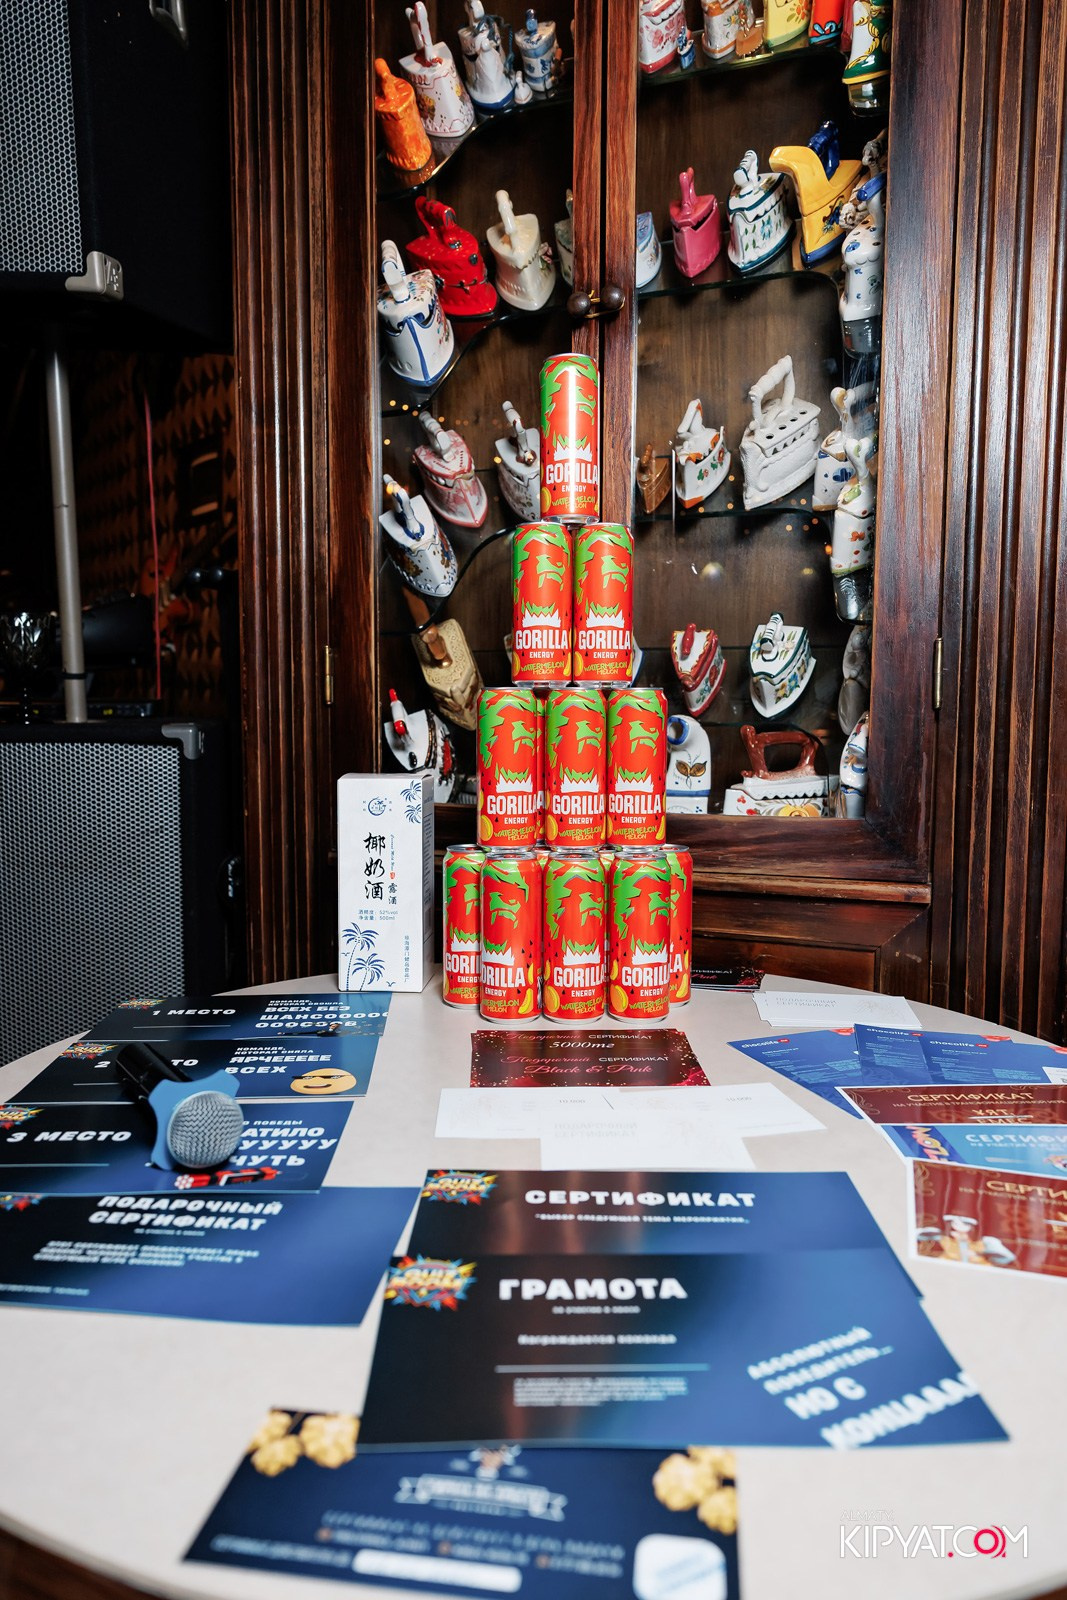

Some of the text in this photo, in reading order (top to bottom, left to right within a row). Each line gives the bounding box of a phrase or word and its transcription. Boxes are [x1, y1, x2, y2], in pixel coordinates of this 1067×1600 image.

[561, 484, 587, 493] ENRGY
[515, 629, 568, 650] GORILLA
[578, 629, 631, 650] GORILLA
[529, 651, 555, 659] ENERGY
[593, 651, 618, 659] ENERGY
[521, 661, 565, 672] WATERMELON
[584, 661, 628, 672] WATERMELON
[552, 793, 605, 815] GORILLA
[608, 793, 662, 814] GORILLA
[504, 816, 529, 825] ENERGY
[568, 816, 594, 825] ENERGY
[621, 815, 647, 824] ENERGY
[614, 825, 657, 837] WATERMELON
[363, 831, 386, 900] 椰奶酒
[445, 952, 481, 974] GORI
[457, 975, 481, 983] ENERG
[622, 963, 670, 988] GORILL
[485, 987, 507, 997] ENERGY
[571, 989, 596, 998] ENERGY
[640, 988, 664, 997] ENERGY
[167, 1008, 237, 1016] МЕСТО
[866, 1027, 909, 1037] chocolife
[929, 1040, 975, 1048] chocolife
[94, 1060, 111, 1069] 2
[224, 1065, 288, 1074] ВСЕХ
[523, 1064, 653, 1075] Black & Pink
[907, 1092, 1034, 1102] СЕРТИФИКАТ
[7, 1130, 132, 1142] 3 МЕСТО
[241, 1127, 326, 1138] АТИЛО
[229, 1154, 306, 1167] ЧУТЬ
[525, 1190, 756, 1207] СЕРТИФИКАТ
[97, 1195, 284, 1216] ПОДАРОЧНЫЙ
[88, 1210, 267, 1231] СЕРТИФИКАТ
[499, 1278, 688, 1300] ГРАМОТА
